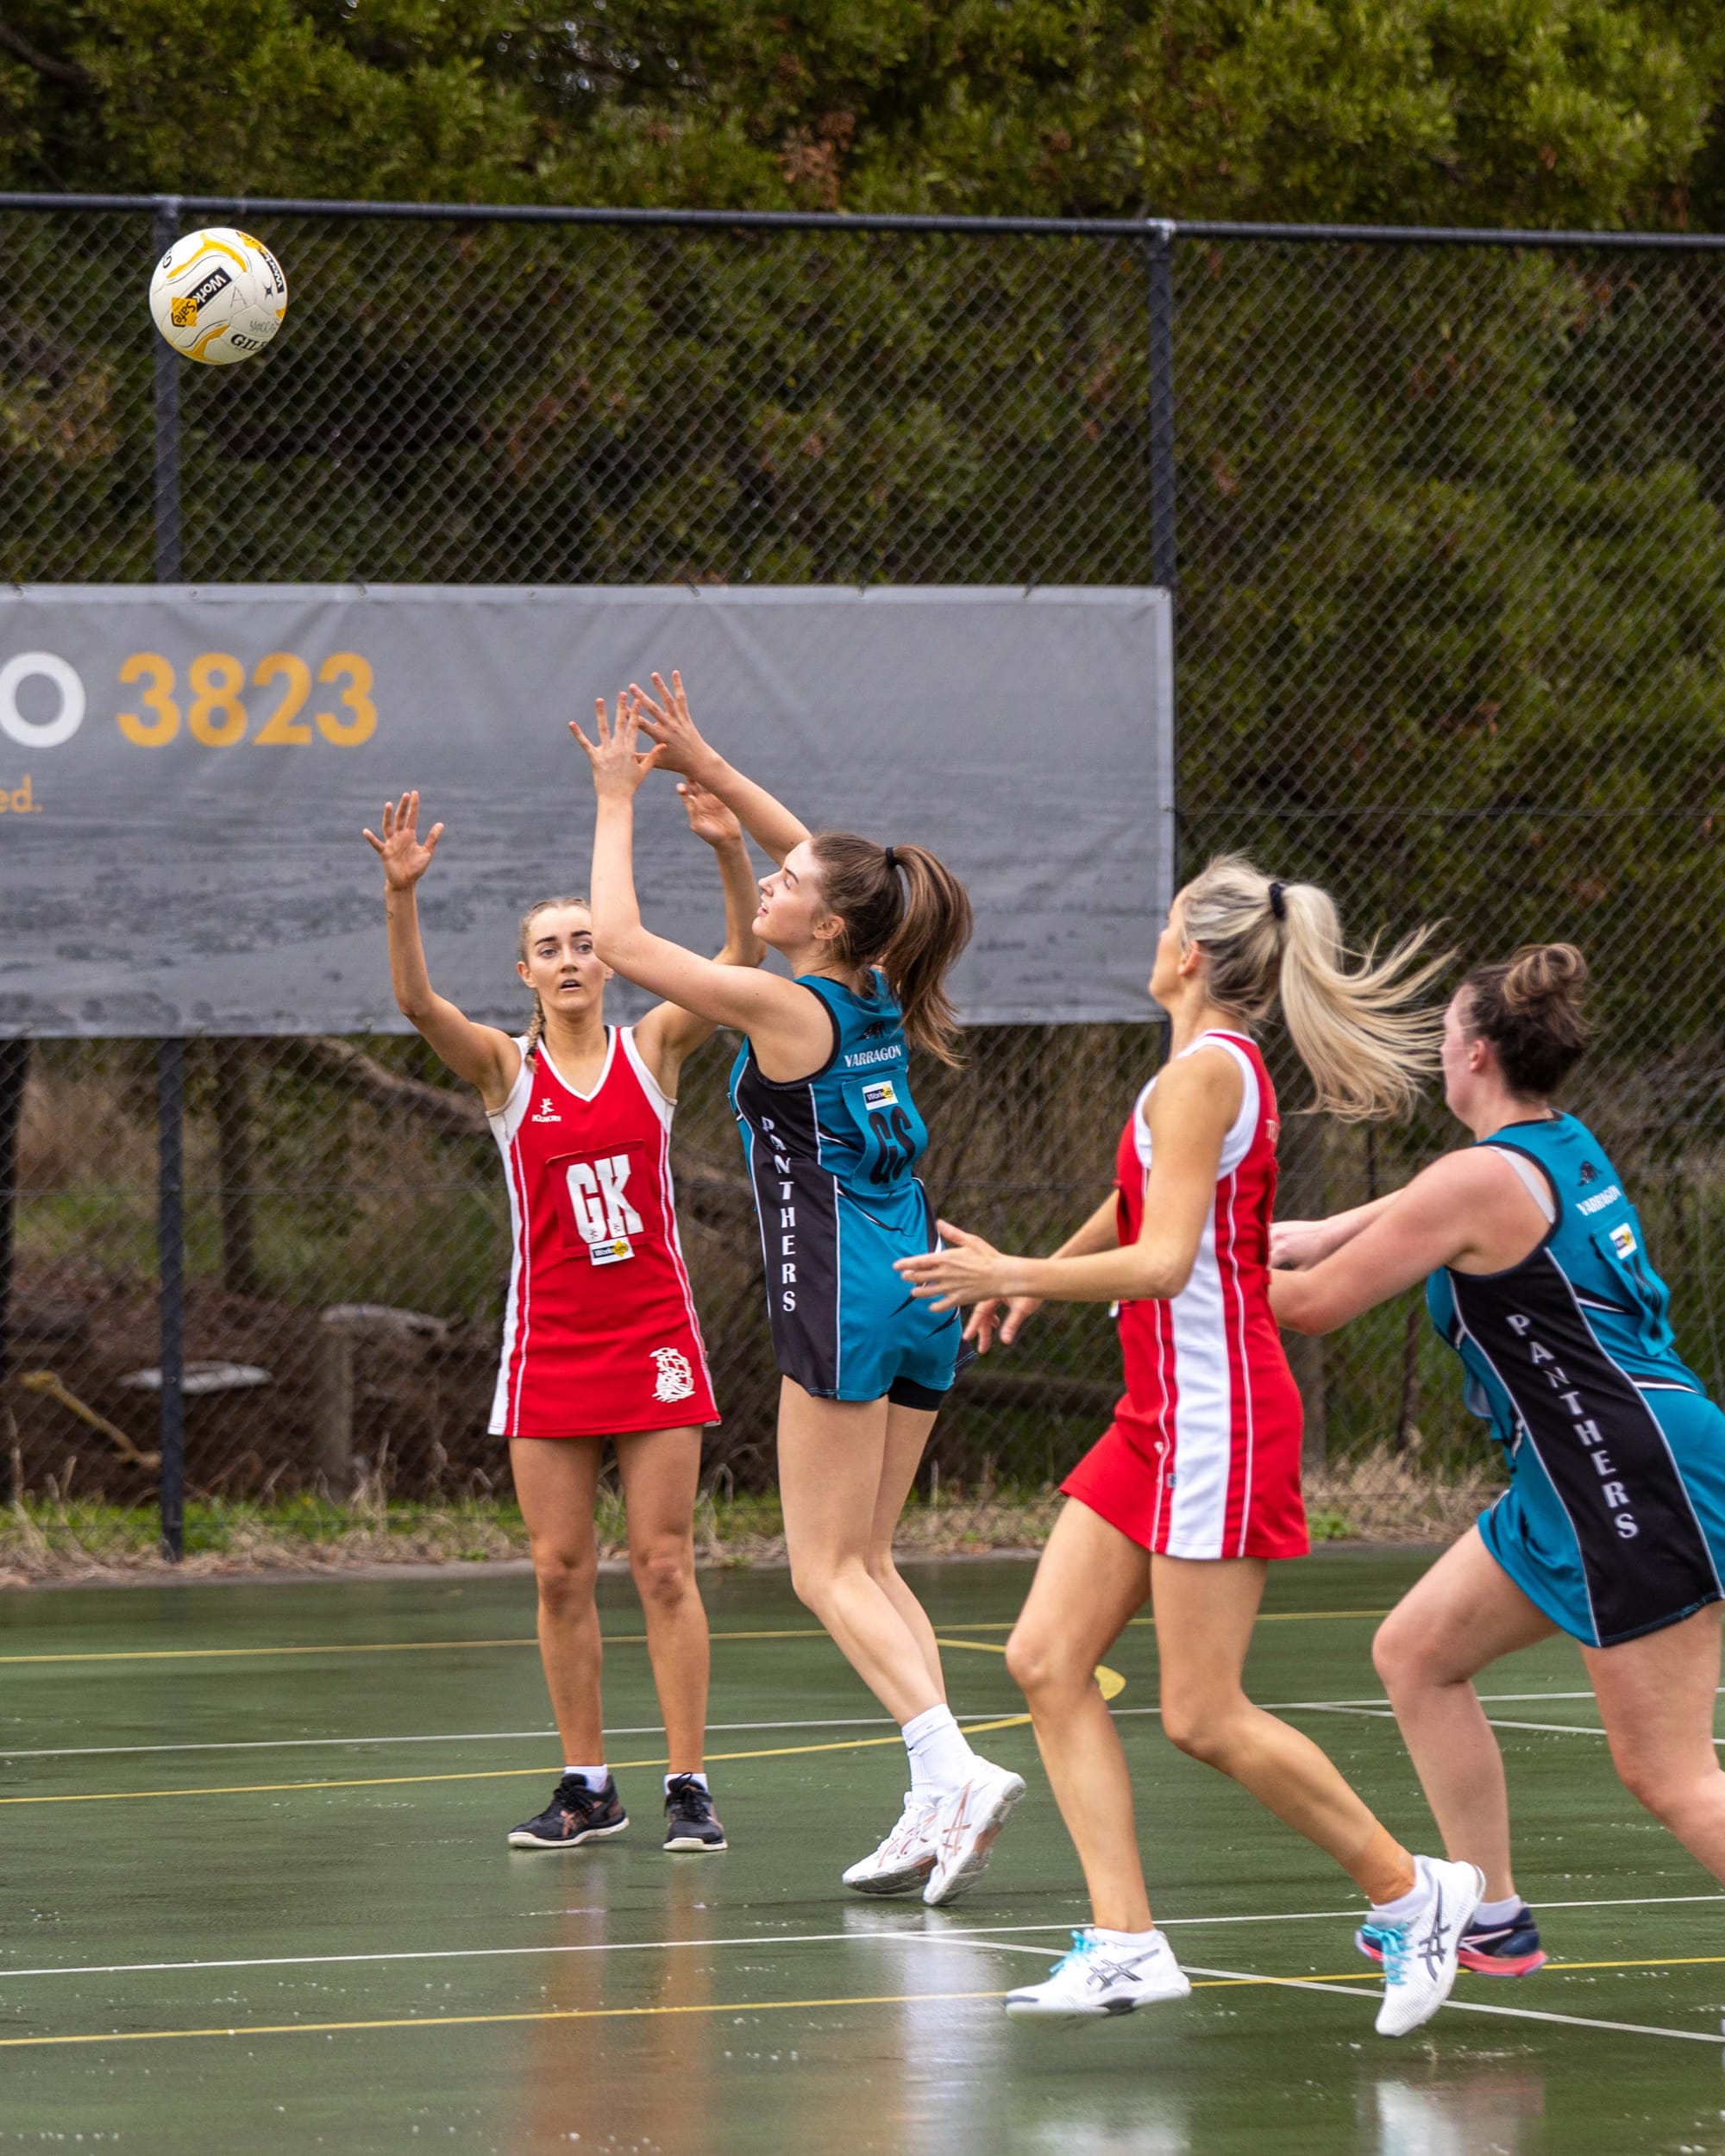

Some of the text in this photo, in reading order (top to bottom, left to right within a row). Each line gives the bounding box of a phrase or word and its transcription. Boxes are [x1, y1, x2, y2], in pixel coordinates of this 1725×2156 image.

[117, 653, 378, 746] 3823
[844, 1044, 901, 1068] YARRAGON
[869, 1106, 915, 1185] GS
[566, 1154, 643, 1243] GK
[762, 1117, 796, 1313] PANTHERS
[1506, 1313, 1639, 1539] PANTHERS
